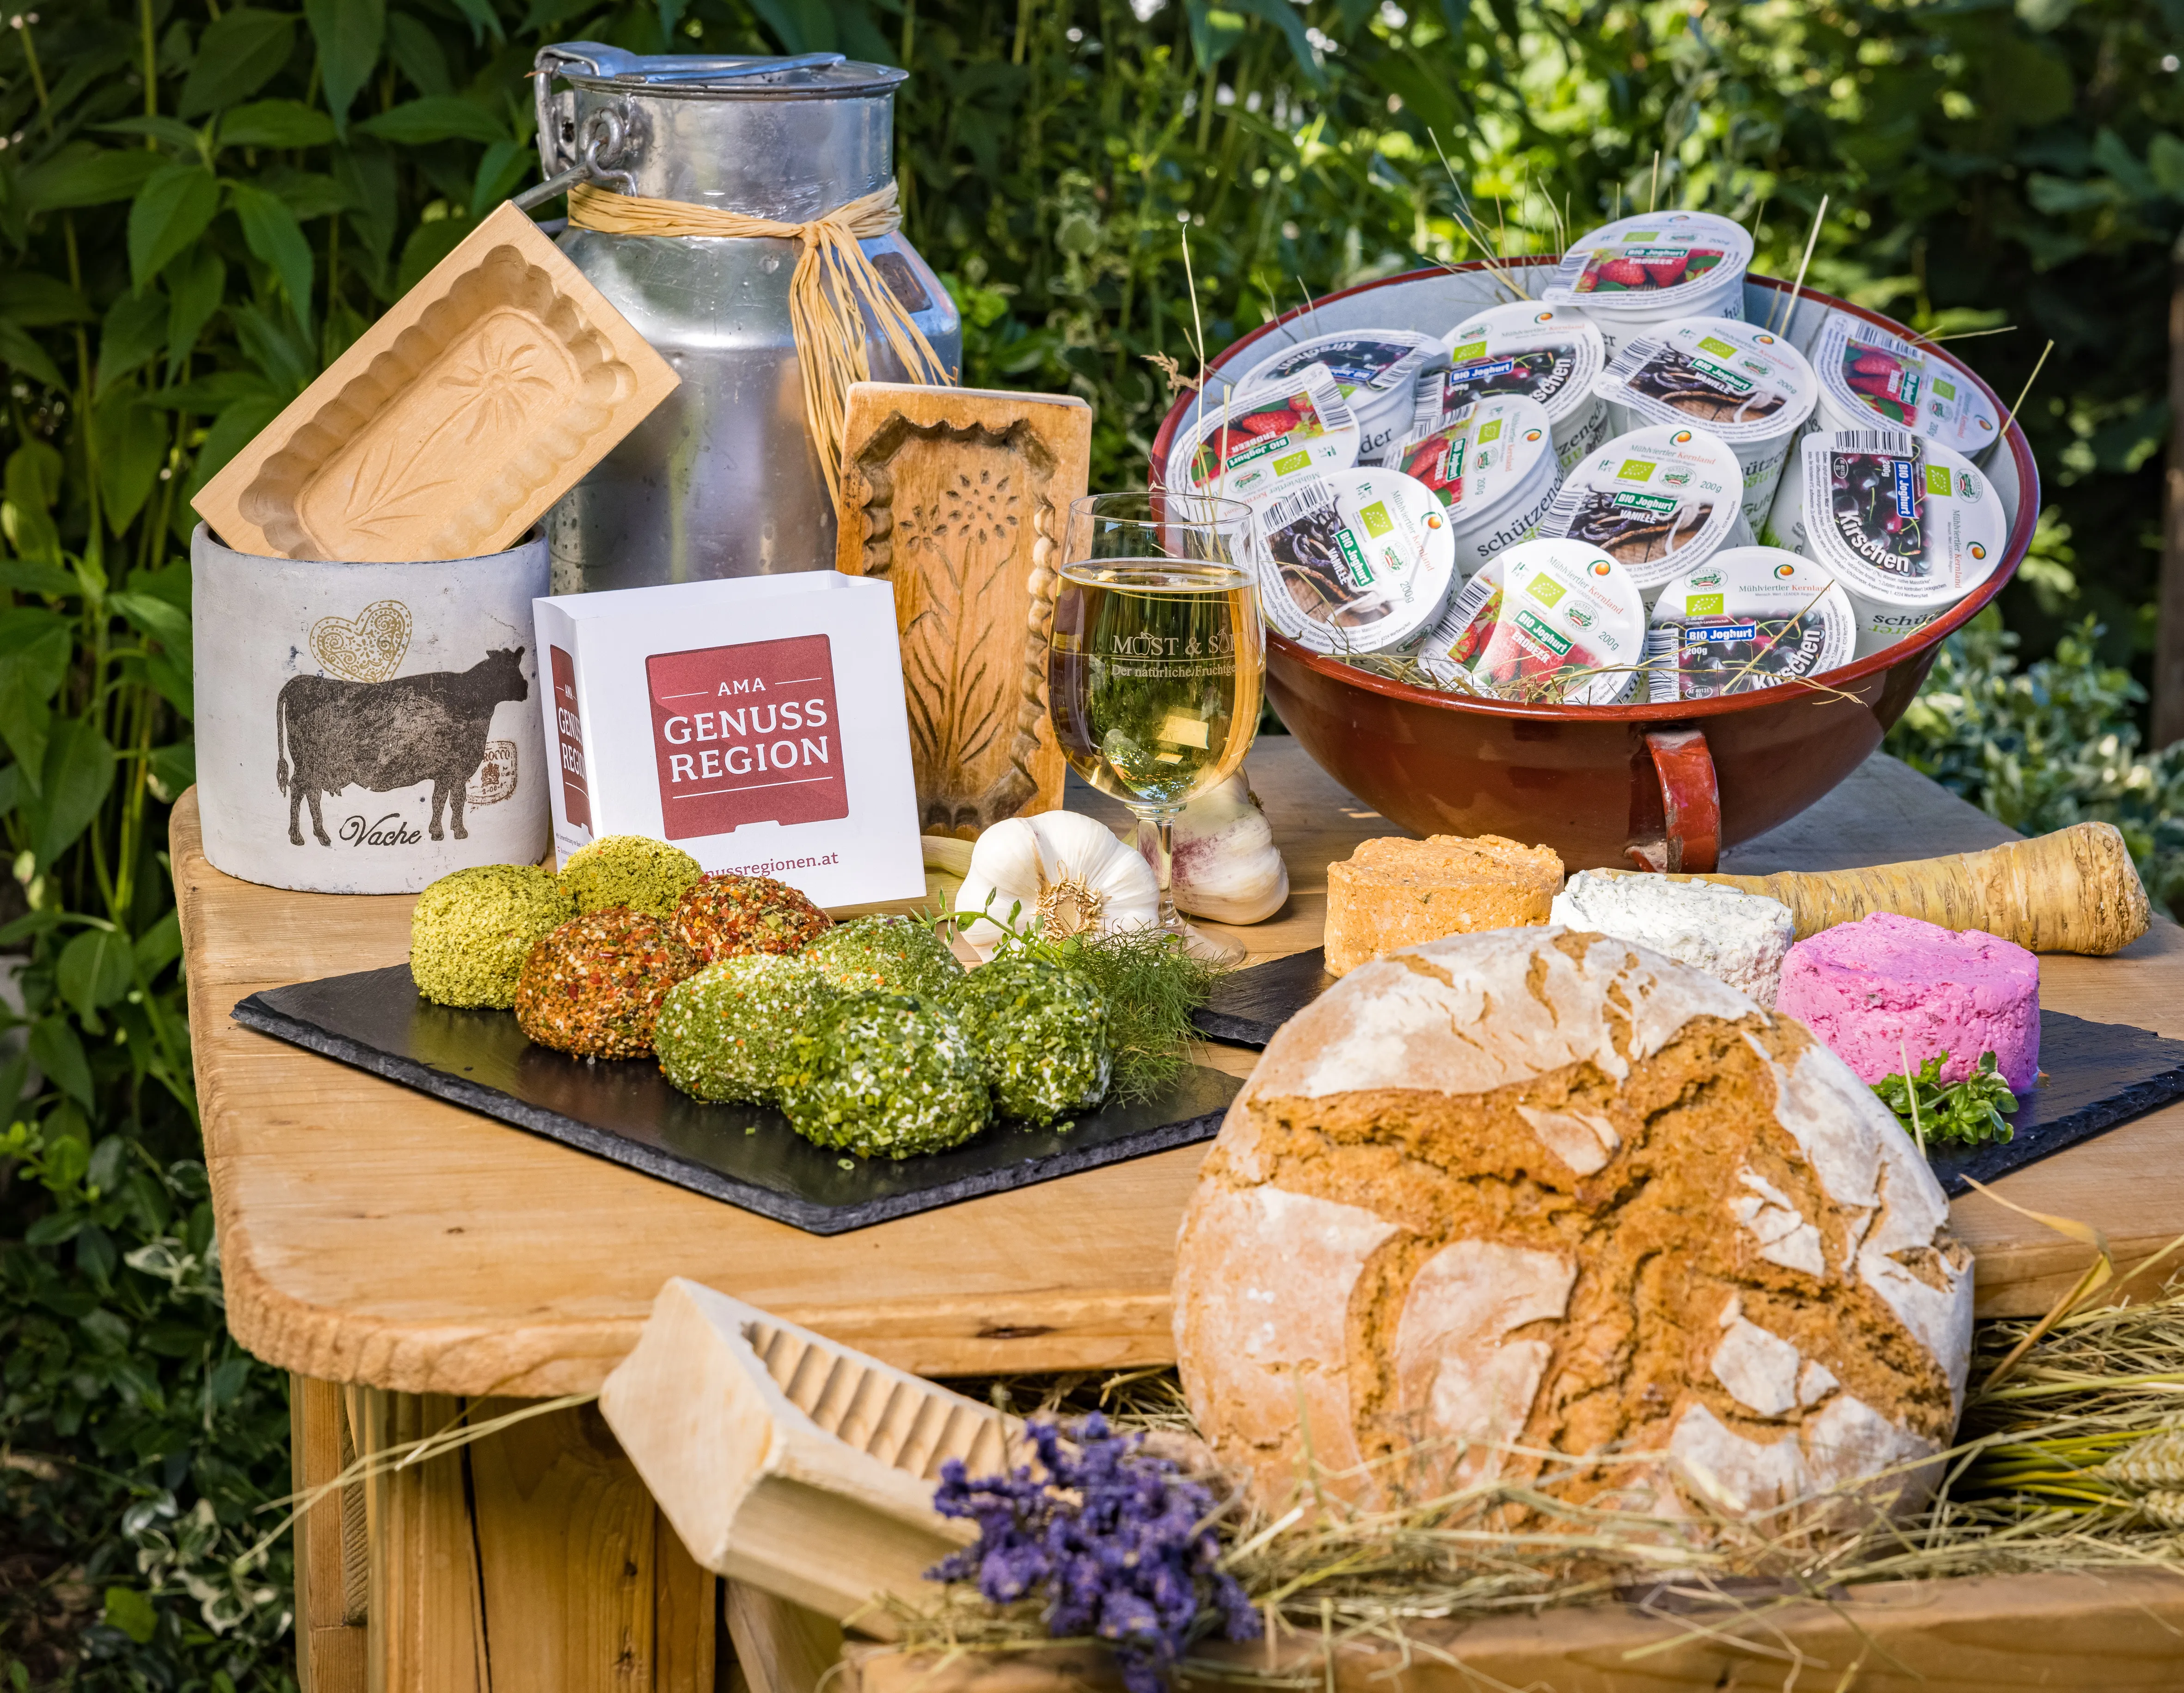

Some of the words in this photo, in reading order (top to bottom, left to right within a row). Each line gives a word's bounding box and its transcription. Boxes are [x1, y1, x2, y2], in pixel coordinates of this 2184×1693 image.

[1275, 340, 1358, 372] Kirschen
[1452, 369, 1470, 380] BIO
[1471, 363, 1510, 378] Joghurt
[1531, 358, 1571, 404] schen
[1693, 371, 1732, 395] VANILLE
[1695, 359, 1712, 372] BIO
[1711, 367, 1750, 391] Joghurt
[1776, 378, 1798, 395] 200g
[1230, 429, 1277, 453] ERDBEER
[1268, 436, 1287, 452] BIO
[1227, 443, 1269, 468] Joghurt
[1629, 444, 1676, 458] Mühlviertler
[1677, 452, 1716, 465] Kernland
[1881, 460, 1890, 477] 200g
[1898, 464, 1908, 478] BIO
[1474, 478, 1485, 495] 200g
[1699, 480, 1722, 493] 200g
[1898, 480, 1910, 514] Joghurt
[1477, 463, 1564, 557] schützened
[1617, 493, 1635, 504] BIO
[1634, 495, 1674, 512] Joghurt
[1619, 508, 1656, 524] VANILLE
[1338, 531, 1356, 549] BIO
[1391, 489, 1418, 536] Mühlviertler
[1411, 534, 1435, 572] Kernland
[1837, 510, 1909, 574] Kirschen
[1952, 508, 1961, 552] Mühlviertler
[1325, 546, 1350, 586] VANILLE
[1344, 546, 1373, 585] Joghurt
[1690, 568, 1709, 577] GUTES
[1953, 554, 1963, 588] Kernland
[1398, 580, 1416, 604] 200g
[1546, 555, 1591, 591] Mühlviertler
[1588, 585, 1625, 615] Kernland
[1738, 583, 1789, 592] Mühlviertler
[1791, 584, 1831, 593] Kernland
[1469, 594, 1490, 619] 430105
[1574, 602, 1590, 611] GUTES
[1588, 609, 1600, 620] VOM
[1517, 611, 1535, 629] BIO
[1532, 623, 1568, 654] Joghurt
[1597, 630, 1620, 652] 200g
[1689, 630, 1707, 639] BIO
[1709, 628, 1753, 640] Joghurt
[1185, 637, 1202, 655] &
[1510, 630, 1551, 664] ERDBEER
[1686, 647, 1708, 655] 200g
[1111, 664, 1132, 676] Der
[1195, 664, 1235, 677] Fruchtge
[718, 678, 766, 697] AMA
[664, 699, 827, 745] GENUSS
[562, 743, 588, 784] REGION
[670, 736, 829, 782] REGION
[338, 813, 422, 847] Vache
[705, 853, 839, 876] nussregionen.at
